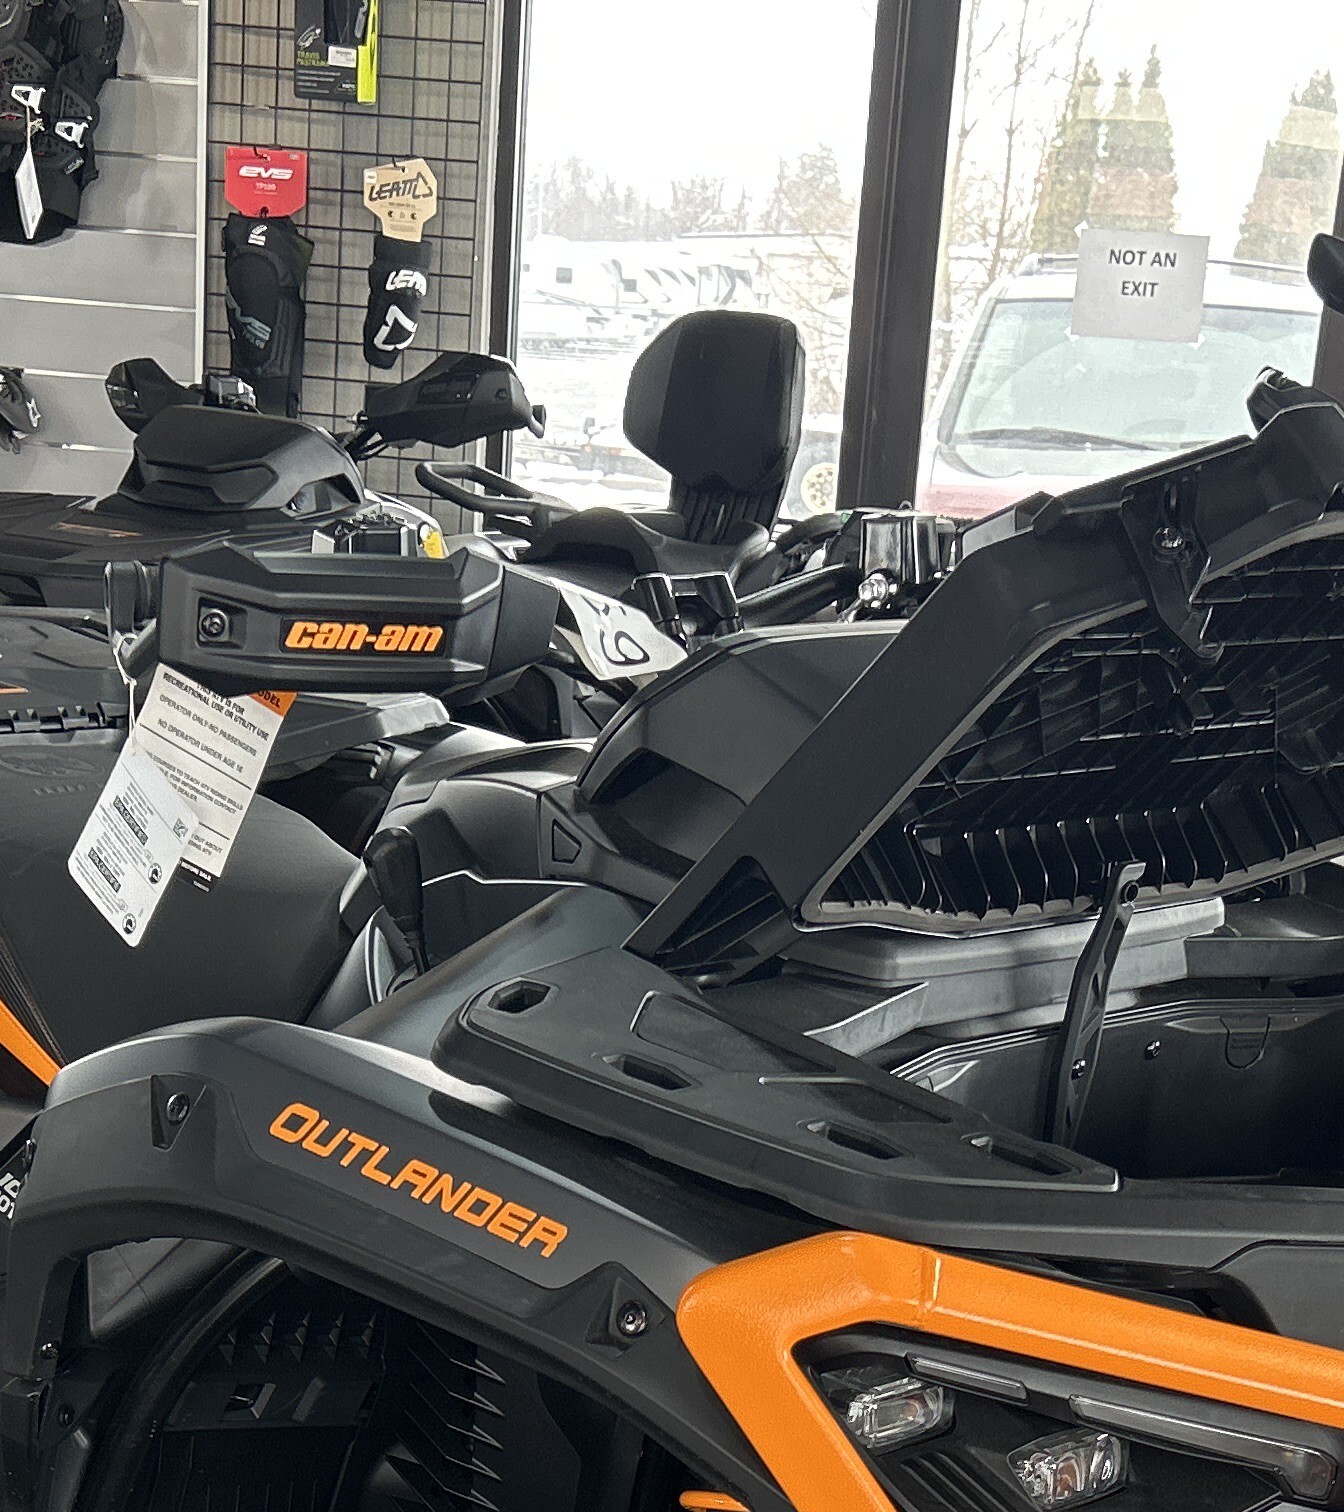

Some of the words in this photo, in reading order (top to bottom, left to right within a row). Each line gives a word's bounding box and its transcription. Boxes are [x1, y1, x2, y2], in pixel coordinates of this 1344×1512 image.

[368, 178, 414, 202] LEATT
[1108, 248, 1148, 266] NOT
[1150, 252, 1178, 268] AN
[1121, 280, 1159, 298] EXIT
[284, 620, 445, 652] can-am
[162, 672, 210, 706] RECREATIONAL
[211, 702, 225, 714] USE
[224, 708, 234, 720] OR
[233, 714, 258, 734] UTILITY
[255, 728, 270, 742] USE
[257, 690, 281, 709] ODEL
[159, 694, 192, 718] OPERATOR
[218, 728, 258, 757] PASSENGERS
[157, 718, 168, 730] NO
[167, 724, 201, 749] OPERATOR
[200, 742, 223, 761] UNDER
[222, 755, 236, 769] AGE
[268, 1102, 569, 1258] OUTLANDER
